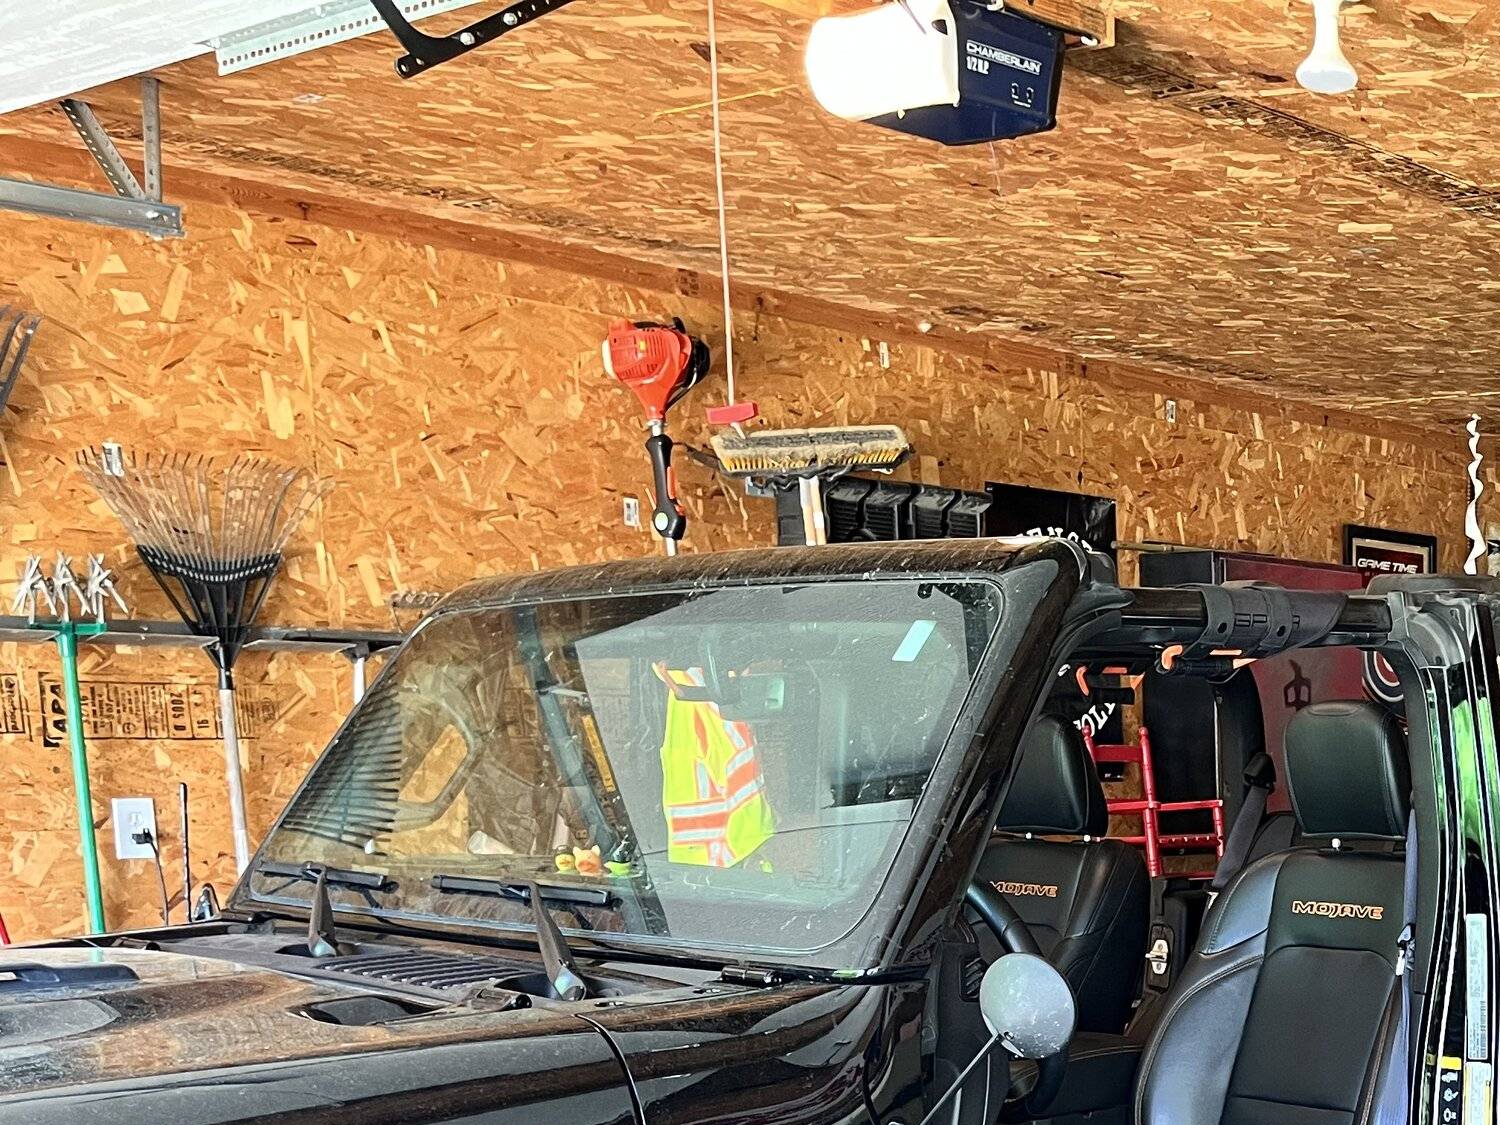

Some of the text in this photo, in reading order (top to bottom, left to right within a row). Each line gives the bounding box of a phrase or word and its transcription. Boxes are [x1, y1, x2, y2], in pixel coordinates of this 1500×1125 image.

[966, 42, 1041, 73] CHAMBERLAIN
[1357, 558, 1419, 574] GAME TIME
[1292, 901, 1384, 920] MOJAVE
